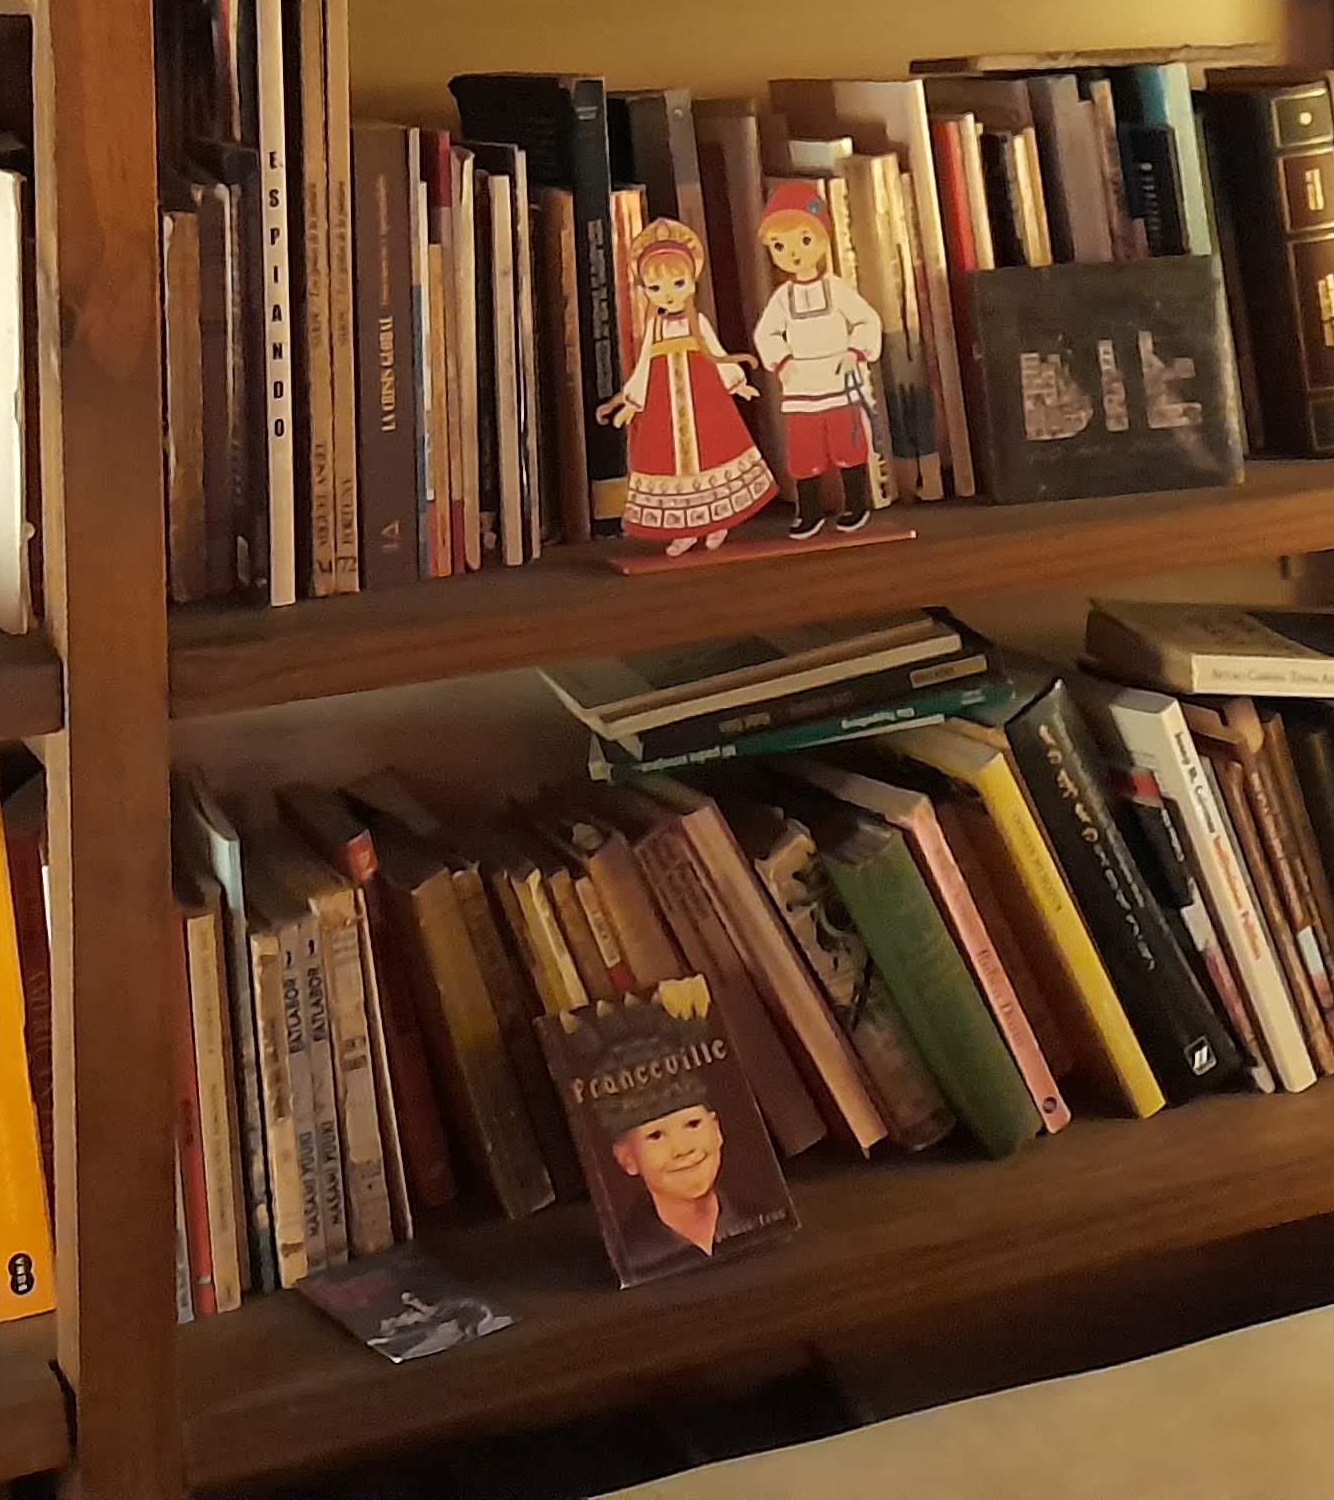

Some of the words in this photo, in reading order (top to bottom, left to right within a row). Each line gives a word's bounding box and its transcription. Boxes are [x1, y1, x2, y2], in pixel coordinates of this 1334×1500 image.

[268, 150, 287, 440] ESPIANDO
[378, 316, 394, 365] GLOBAL
[379, 369, 396, 410] CRISIS
[381, 414, 396, 431] LA
[315, 491, 328, 547] MIGUEL
[296, 1131, 316, 1174] YUUKI
[301, 1178, 322, 1236] MASAMI
[324, 1166, 343, 1224] MASAMI
